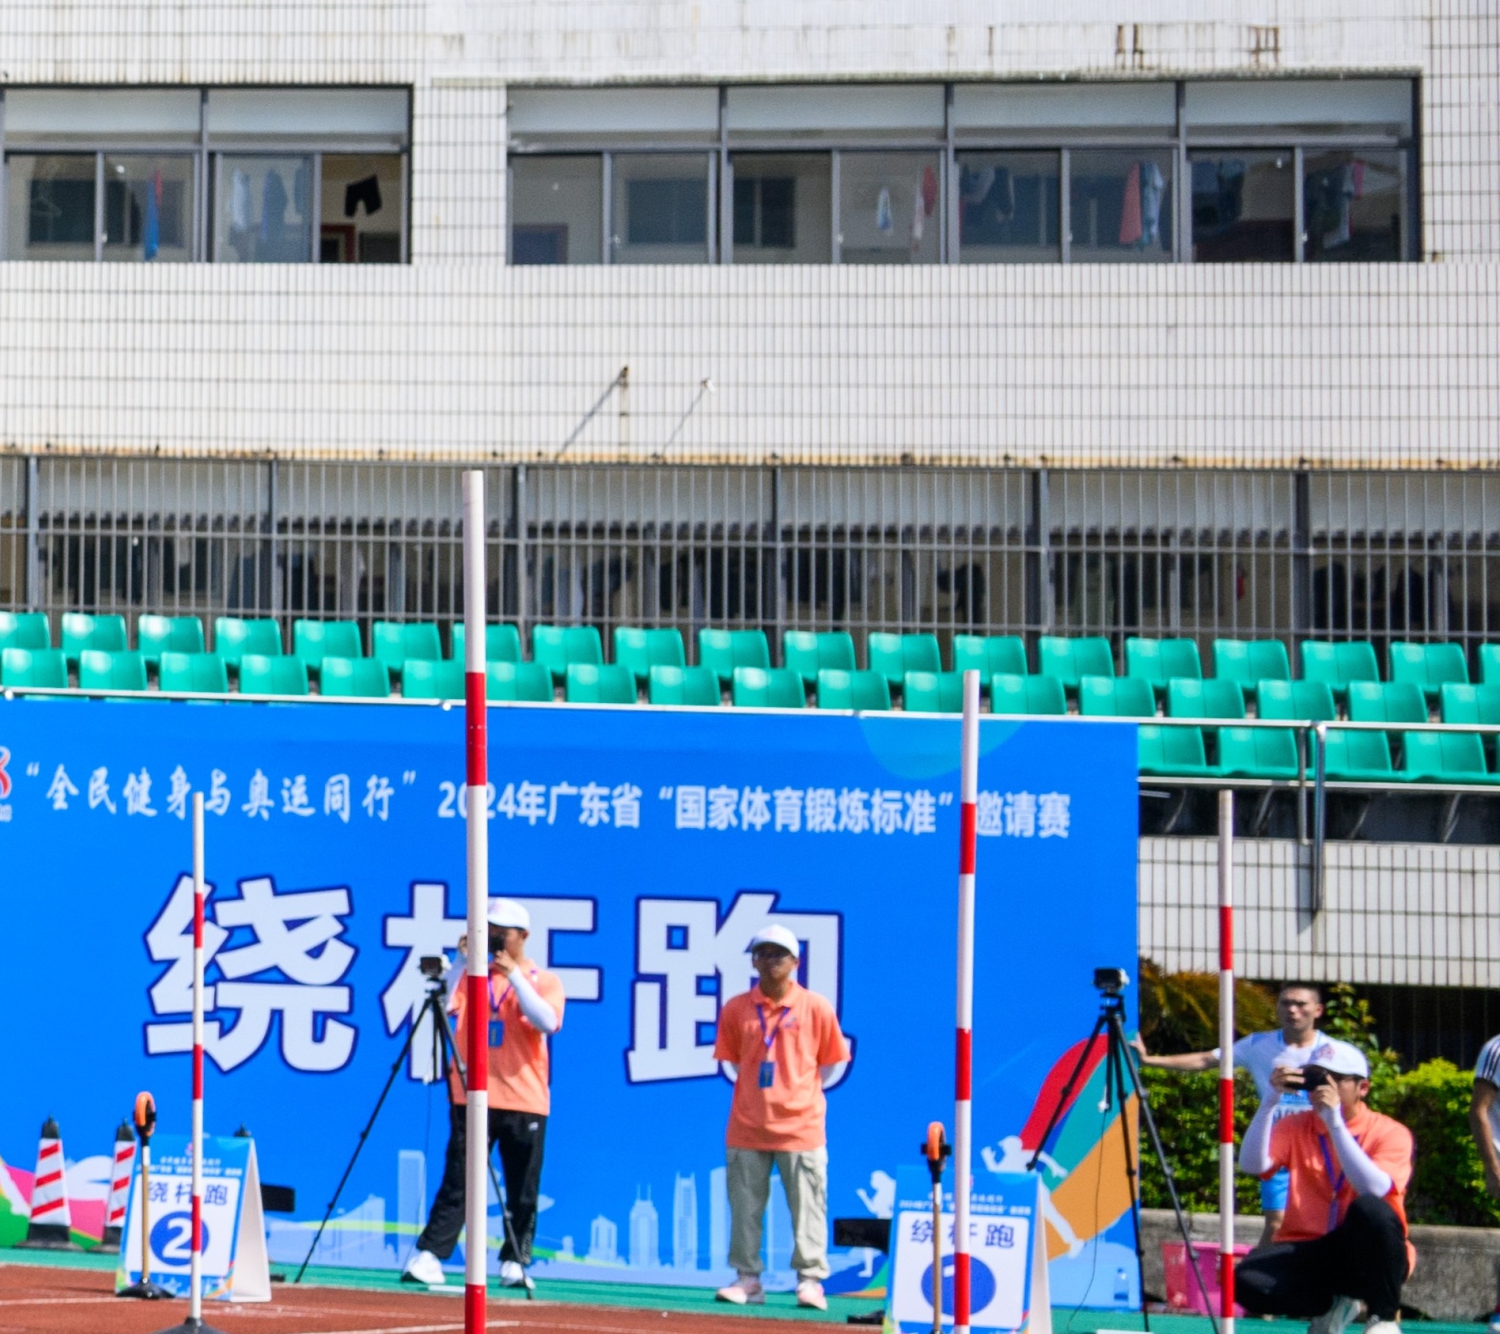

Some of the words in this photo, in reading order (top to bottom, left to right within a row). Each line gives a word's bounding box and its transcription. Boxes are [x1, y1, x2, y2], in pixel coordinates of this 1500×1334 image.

[26, 761, 417, 824] “全民健身与奥运同行”
[975, 789, 1072, 839] 邀请赛
[145, 875, 856, 1089] 绕杆跑
[162, 1216, 193, 1259] 2
